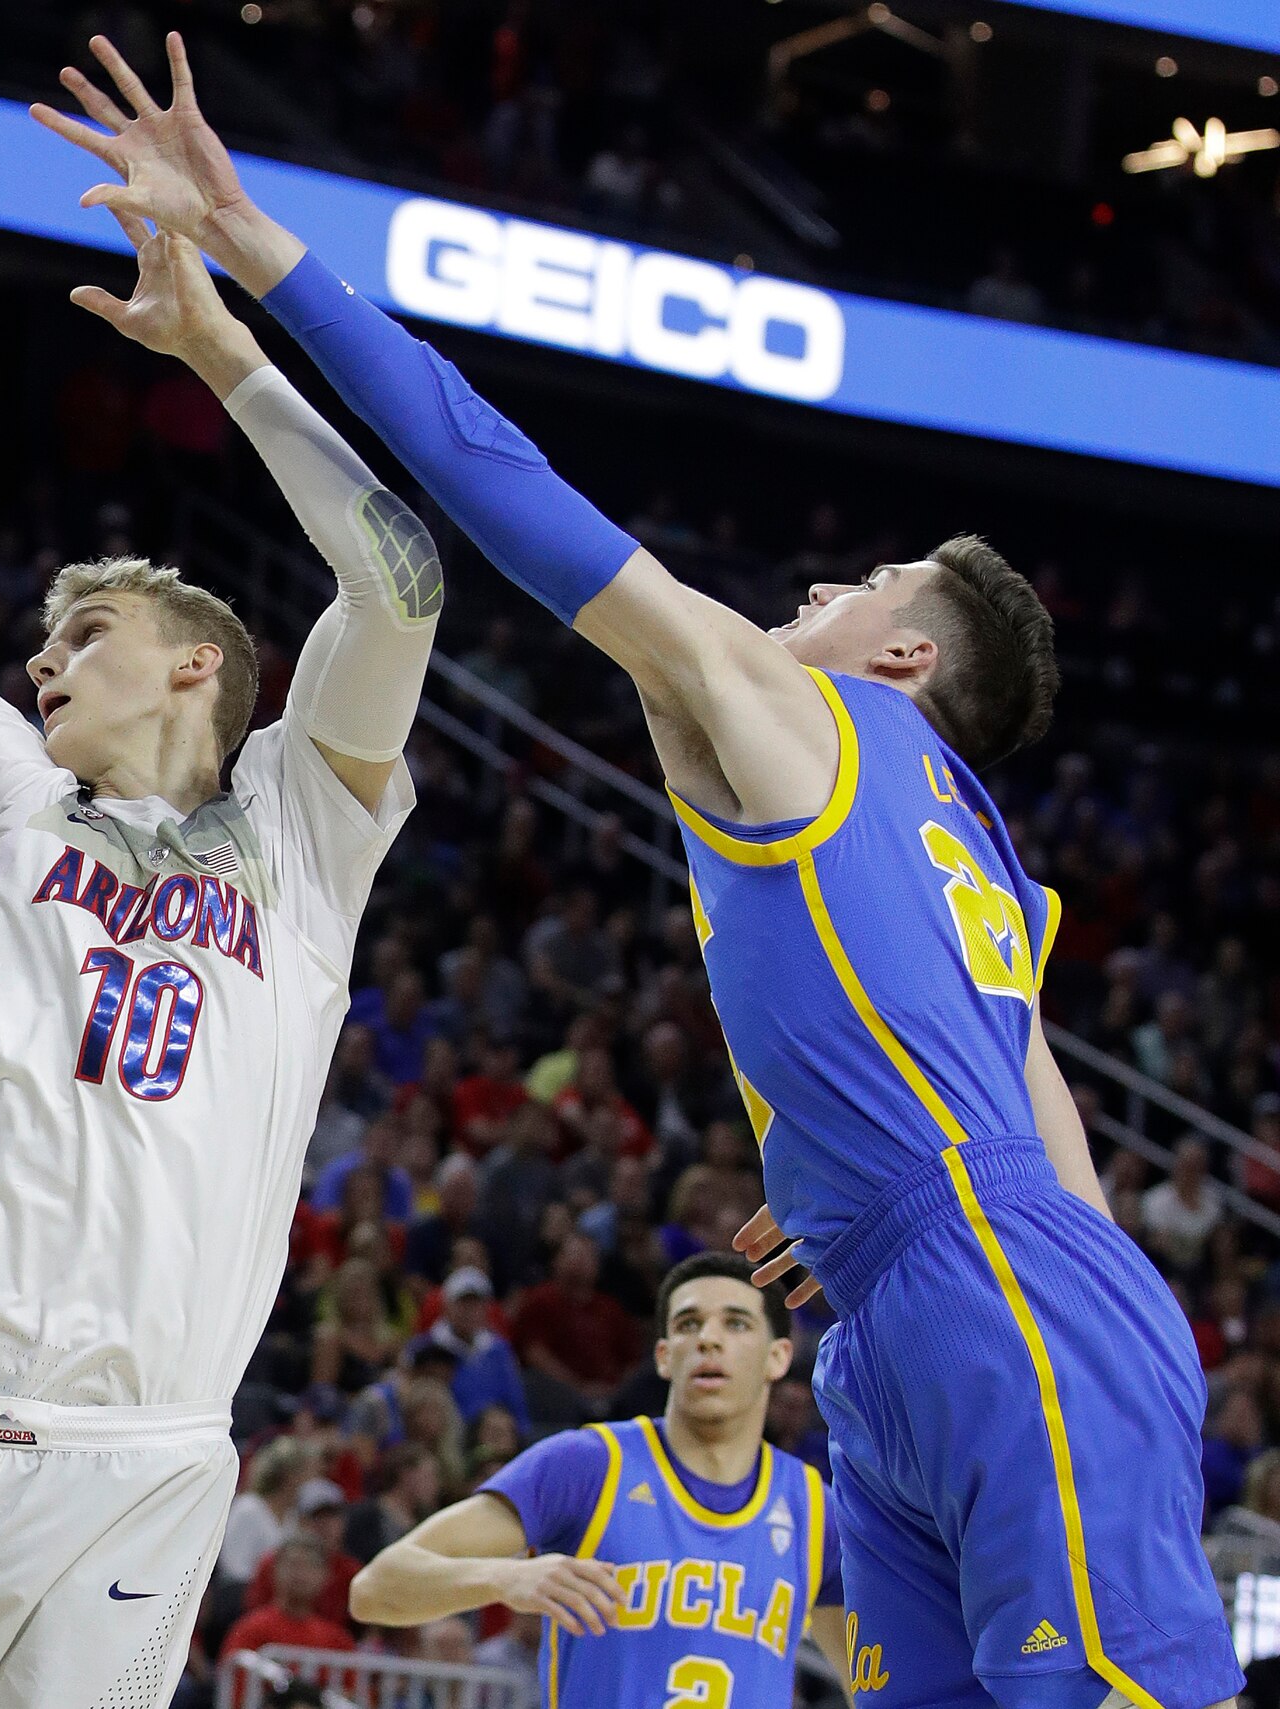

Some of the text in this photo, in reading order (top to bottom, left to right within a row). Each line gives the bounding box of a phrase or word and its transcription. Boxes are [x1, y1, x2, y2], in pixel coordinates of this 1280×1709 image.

[385, 196, 844, 402] GEICO
[31, 844, 264, 982] ARIZONA
[74, 946, 203, 1101] 10
[612, 1557, 795, 1659] UCLA
[1021, 1634, 1068, 1655] adidas
